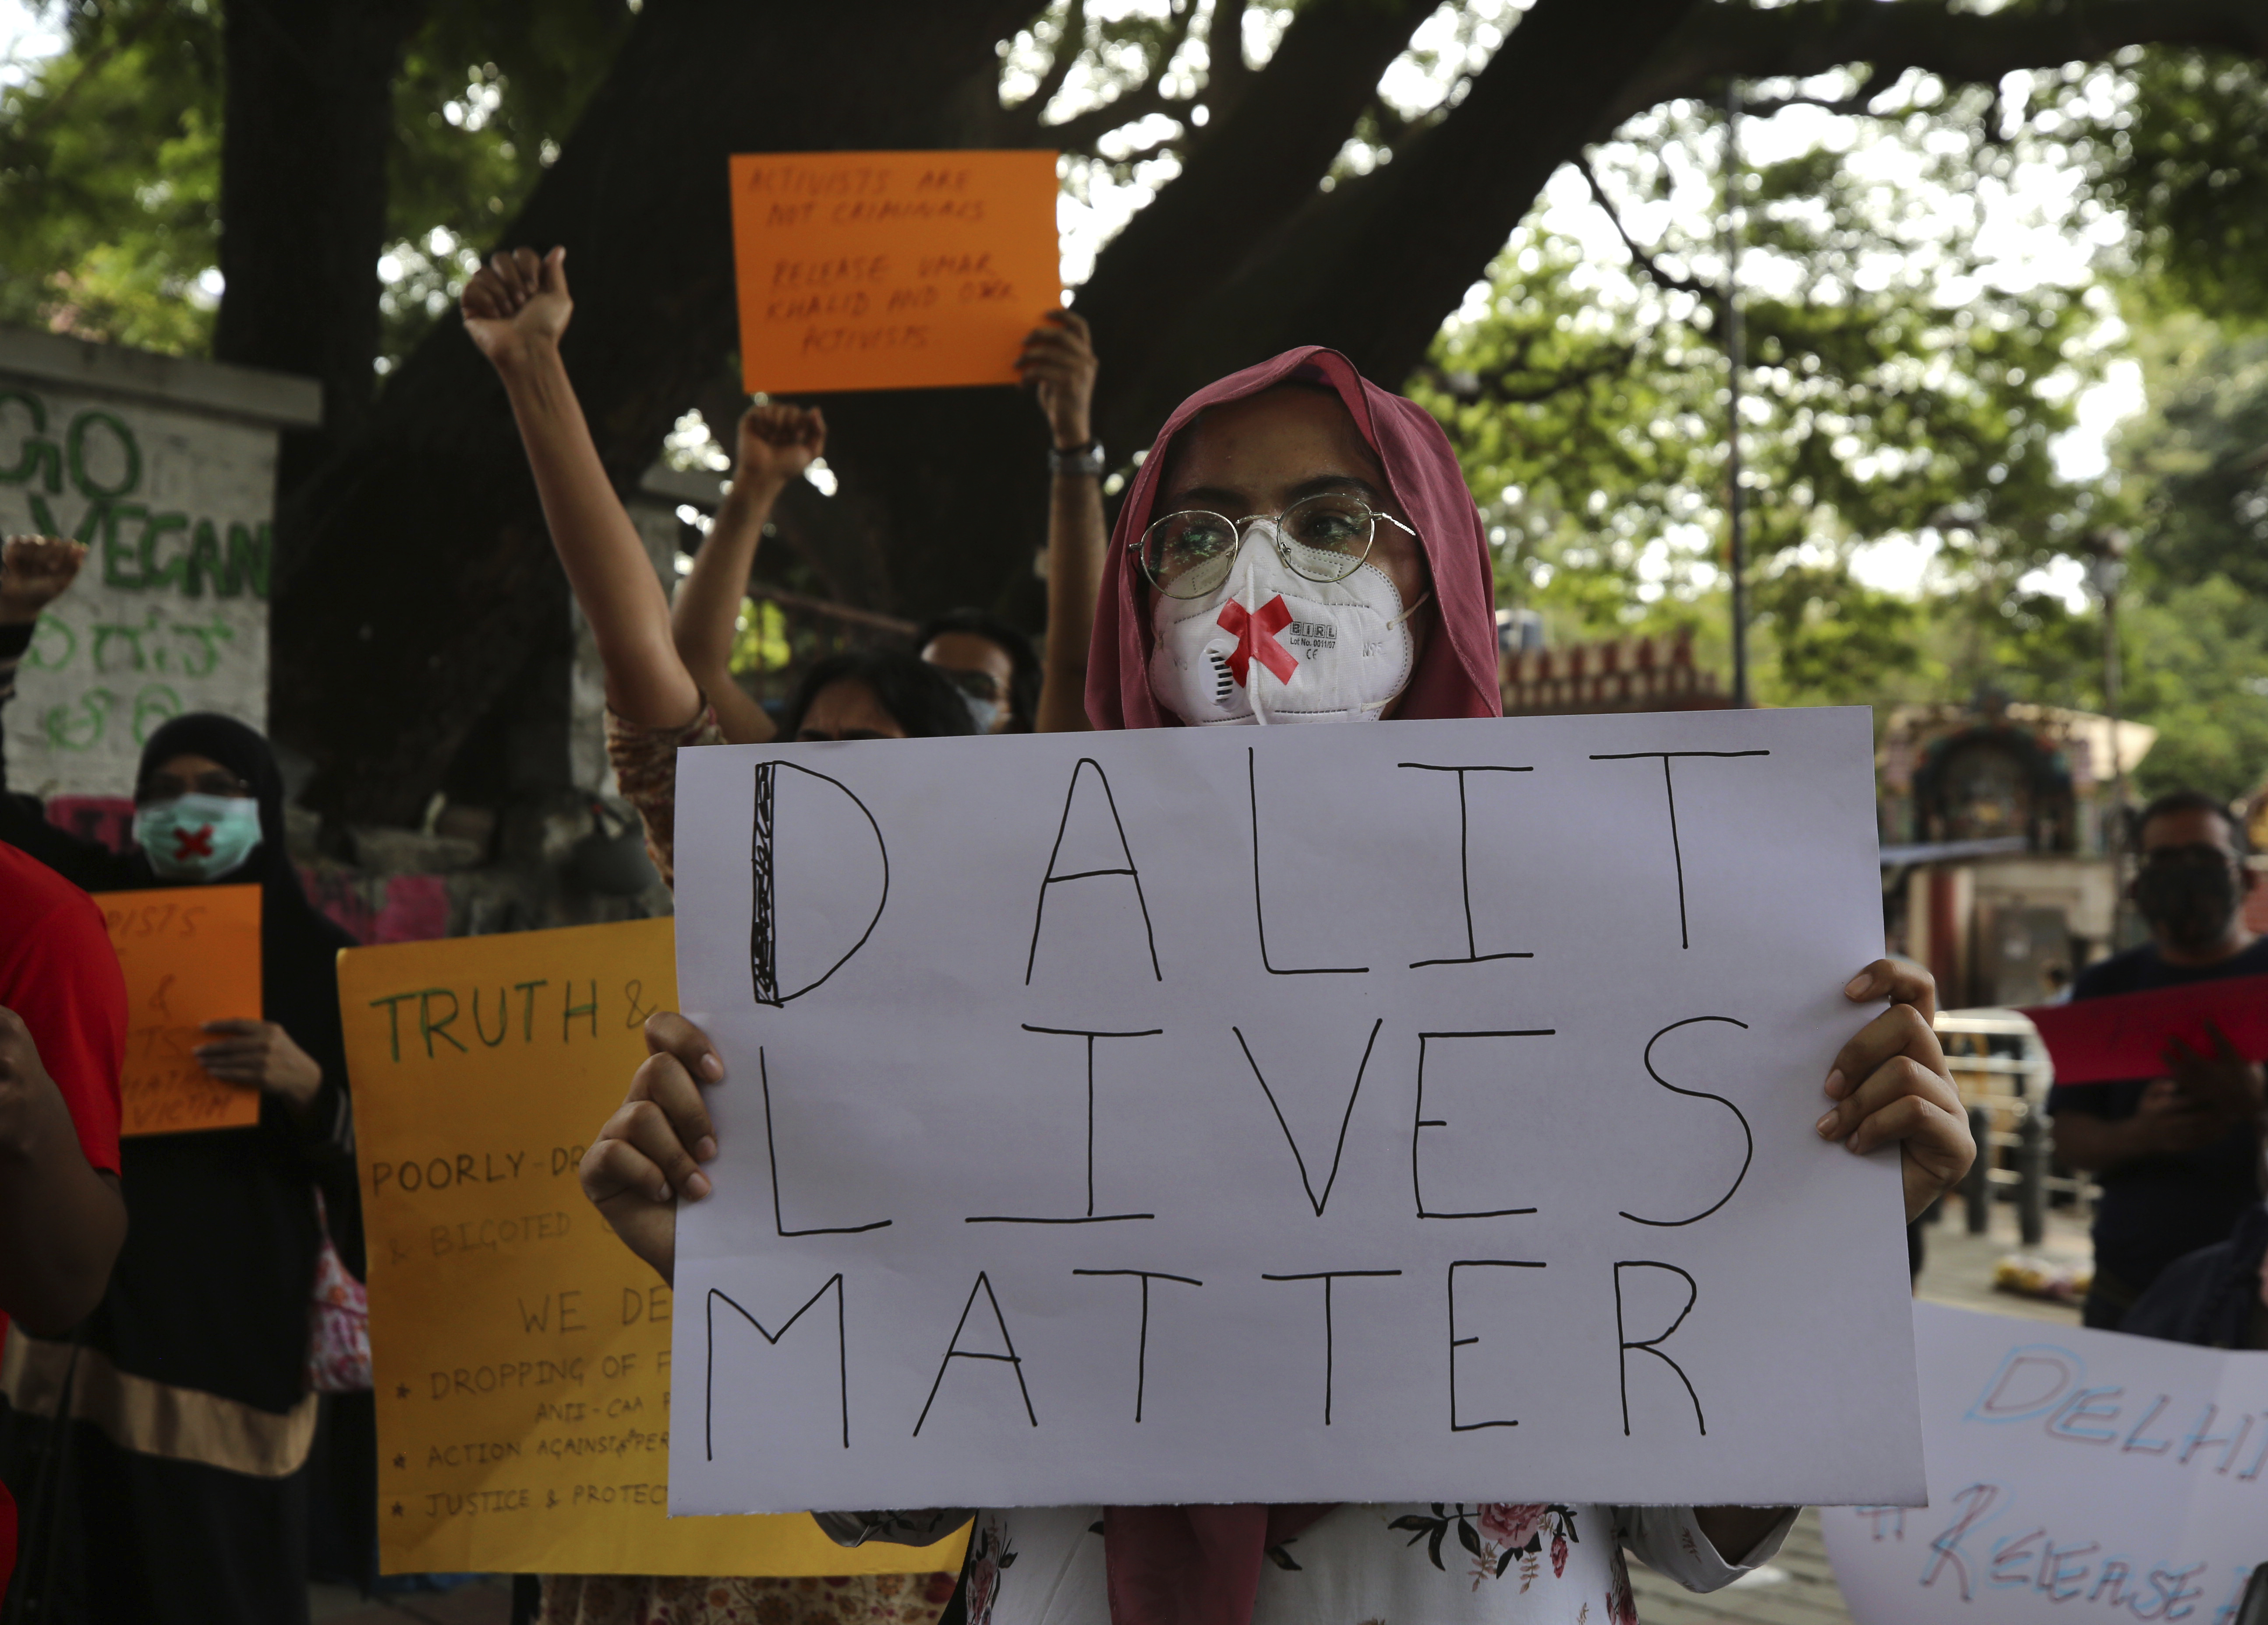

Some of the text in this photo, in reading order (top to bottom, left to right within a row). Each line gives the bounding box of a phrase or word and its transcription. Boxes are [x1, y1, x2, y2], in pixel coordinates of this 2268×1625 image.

[766, 199, 816, 227] NOT
[771, 252, 889, 290] RELEASE
[764, 291, 871, 321] KHALID
[887, 285, 938, 313] AND
[0, 388, 142, 499] GO
[1290, 637, 1300, 646] Lot
[1301, 638, 1311, 647] No.
[751, 747, 1770, 1008] DALIT
[369, 979, 657, 1063] TRUTH &
[760, 1016, 1752, 1236] LIVES
[430, 1212, 571, 1257] BIGOTED
[517, 1290, 587, 1333] WE
[430, 1357, 585, 1400] DROPPING
[601, 1353, 637, 1379] OF
[707, 1260, 1706, 1461] MATTER
[427, 1441, 522, 1469] ACTION
[425, 1483, 668, 1517] JUSTICE & PROTEC
